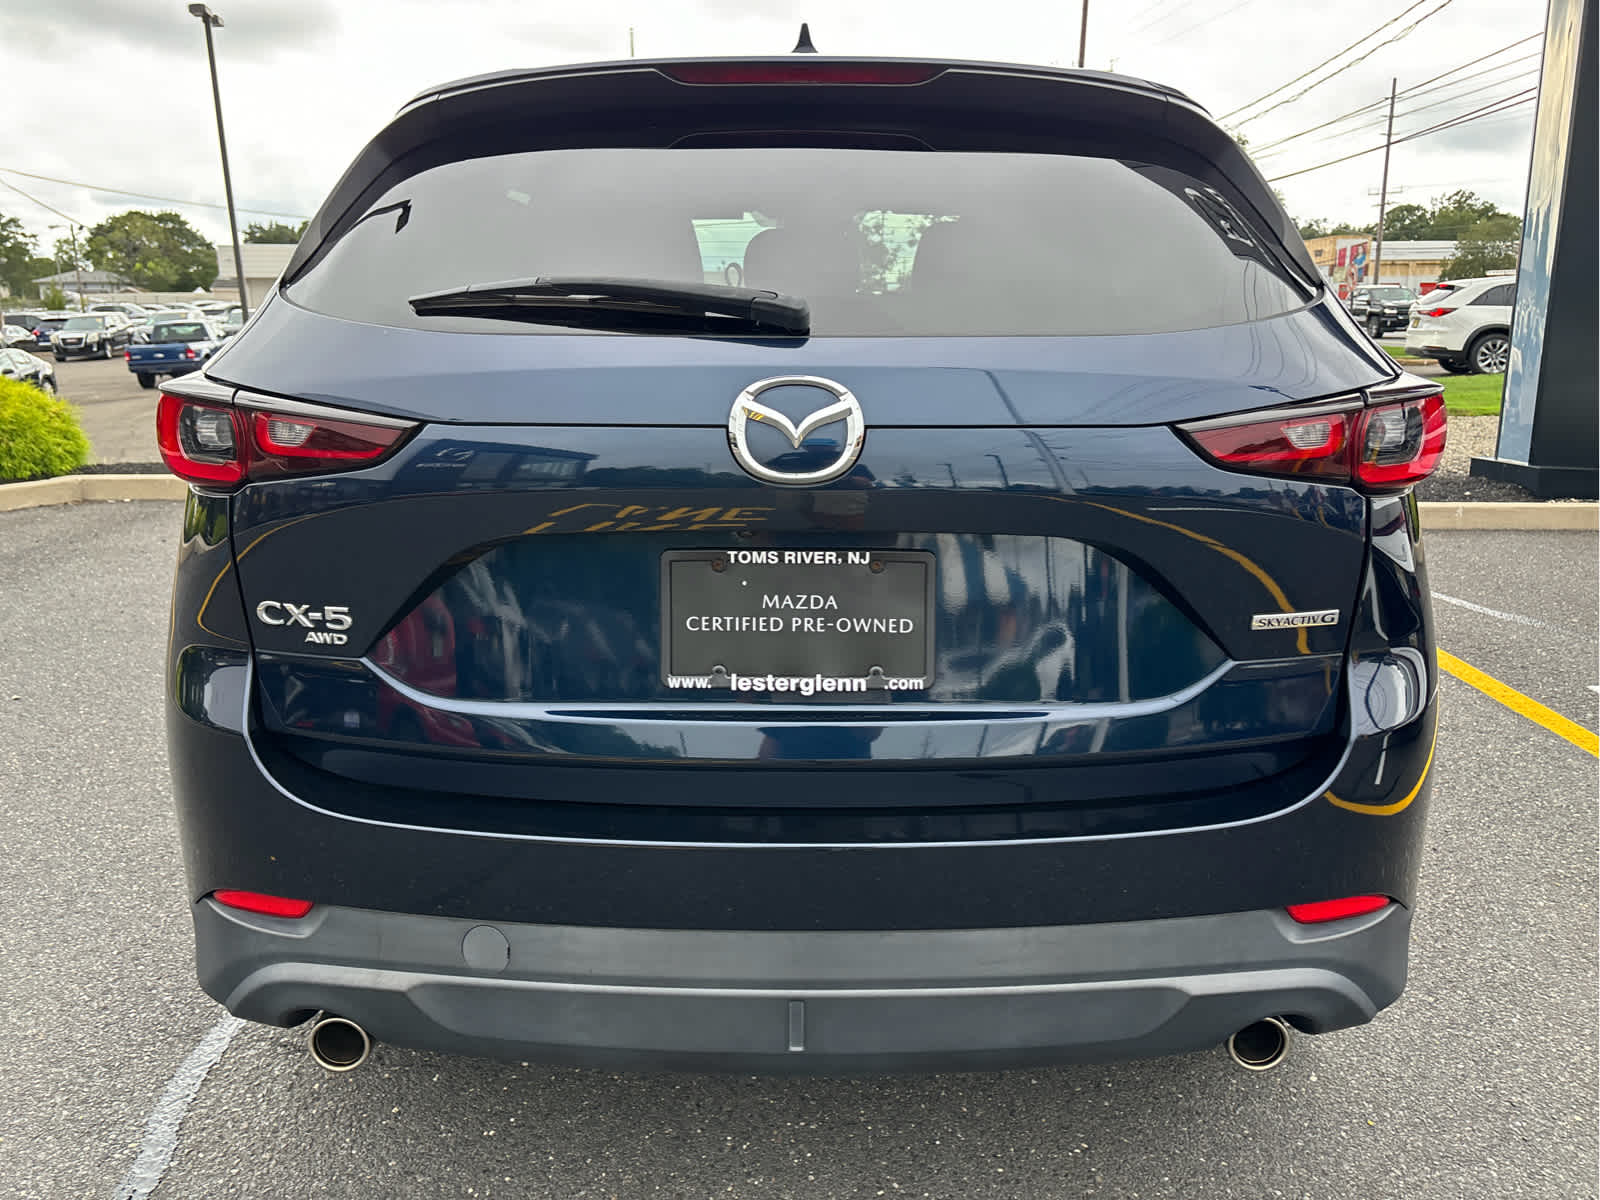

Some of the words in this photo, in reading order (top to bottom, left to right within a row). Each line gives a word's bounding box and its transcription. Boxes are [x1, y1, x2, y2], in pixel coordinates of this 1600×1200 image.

[727, 550, 779, 565] TOMS
[785, 551, 842, 566] RIVER,
[848, 551, 870, 565] NJ
[762, 594, 838, 610] MAZDA
[256, 600, 353, 631] CX-5
[686, 615, 784, 632] CERTIFIED
[791, 617, 914, 634] PRE-OWNED
[304, 631, 348, 645] AWD
[667, 675, 713, 689] www.
[730, 673, 867, 697] lesterglenn
[884, 677, 924, 690] .com
